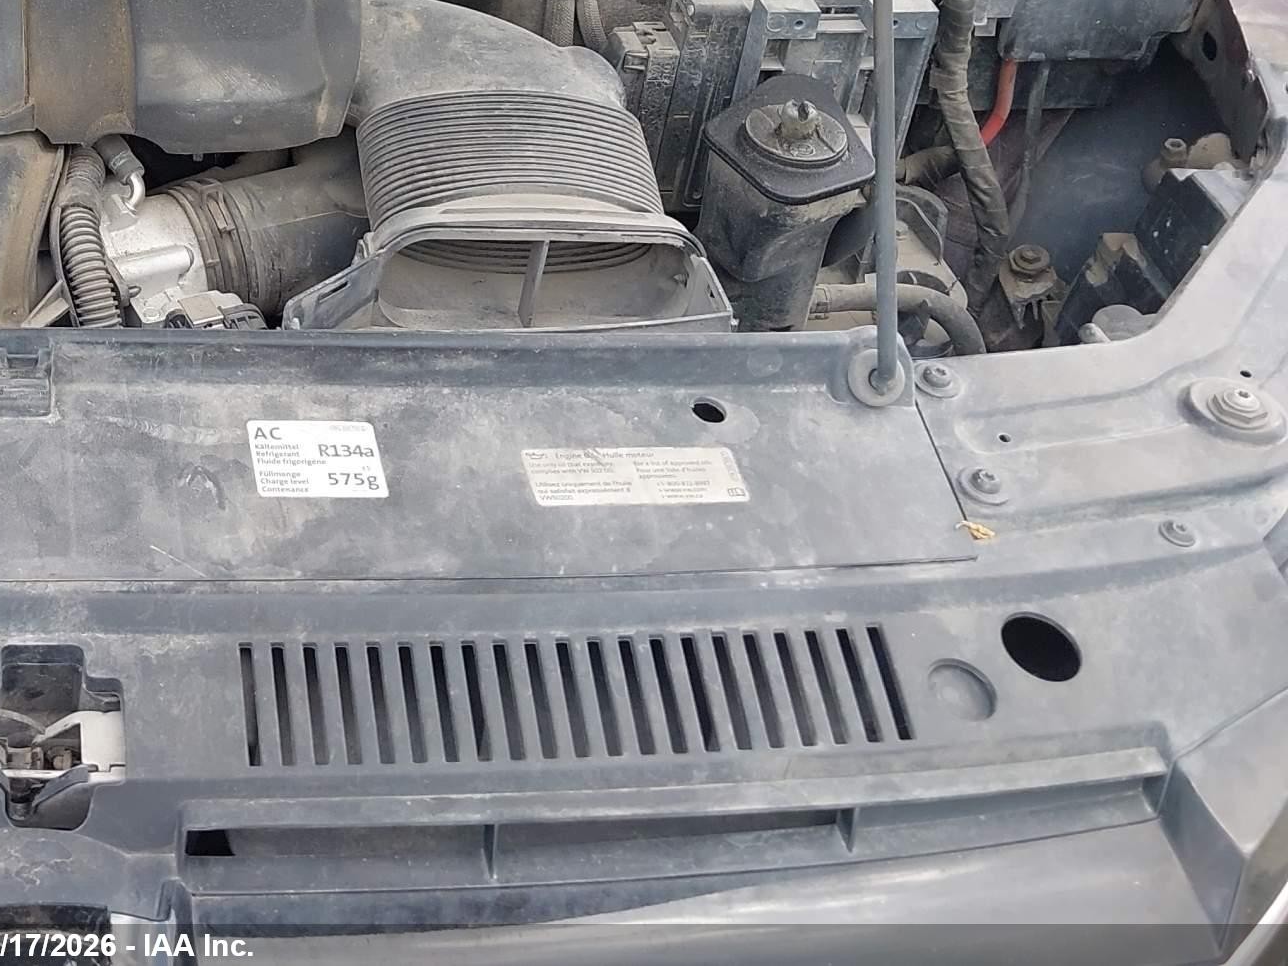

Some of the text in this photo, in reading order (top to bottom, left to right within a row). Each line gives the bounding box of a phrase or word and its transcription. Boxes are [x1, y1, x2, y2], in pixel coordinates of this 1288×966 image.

[254, 427, 283, 440] AC
[256, 450, 300, 458] Refrigerant
[318, 444, 375, 457] R134a
[260, 477, 289, 486] Charge
[328, 473, 380, 490] 575g
